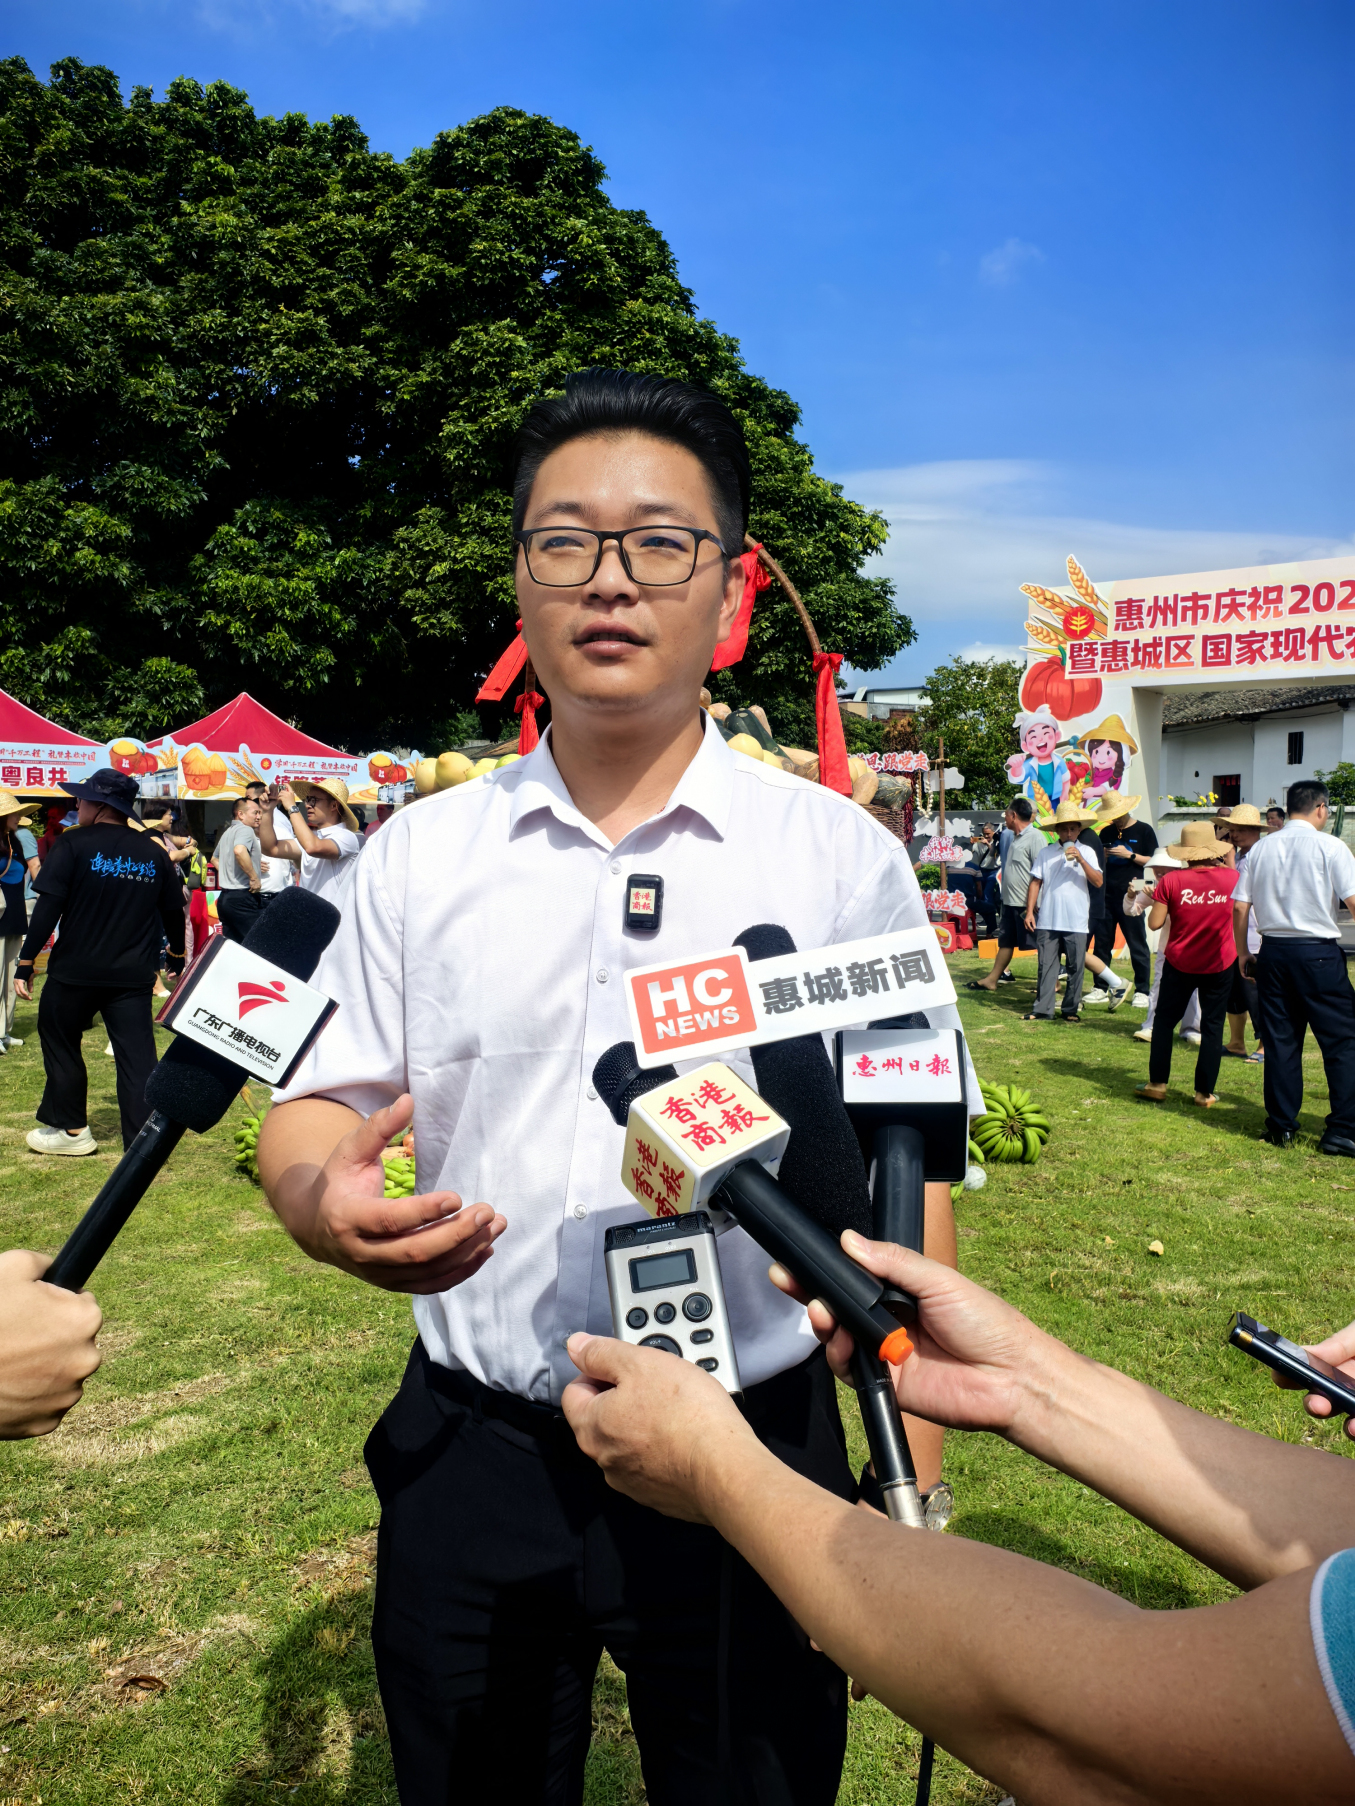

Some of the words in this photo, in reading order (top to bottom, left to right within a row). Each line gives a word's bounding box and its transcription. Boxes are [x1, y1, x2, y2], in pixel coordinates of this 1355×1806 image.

[1113, 579, 1355, 632] 惠州市庆祝202
[1, 765, 68, 788] 粤良井
[919, 847, 963, 861] 丰收故事
[929, 836, 954, 849] 我的
[632, 890, 652, 902] 香港
[1180, 889, 1205, 906] Red
[1207, 889, 1228, 905] Sun
[646, 968, 734, 1019] HC
[758, 947, 937, 1016] 惠城新闻
[192, 1007, 282, 1063] 广东广播电视台
[655, 1005, 741, 1041] NEWS
[187, 1019, 220, 1040] GUANGDONG
[219, 1037, 236, 1049] RADIO
[234, 1046, 247, 1055] AND
[246, 1051, 275, 1071] TELEVISION
[659, 1079, 737, 1126] 香港
[630, 1137, 659, 1200] 香港
[636, 1221, 676, 1233] marantz
